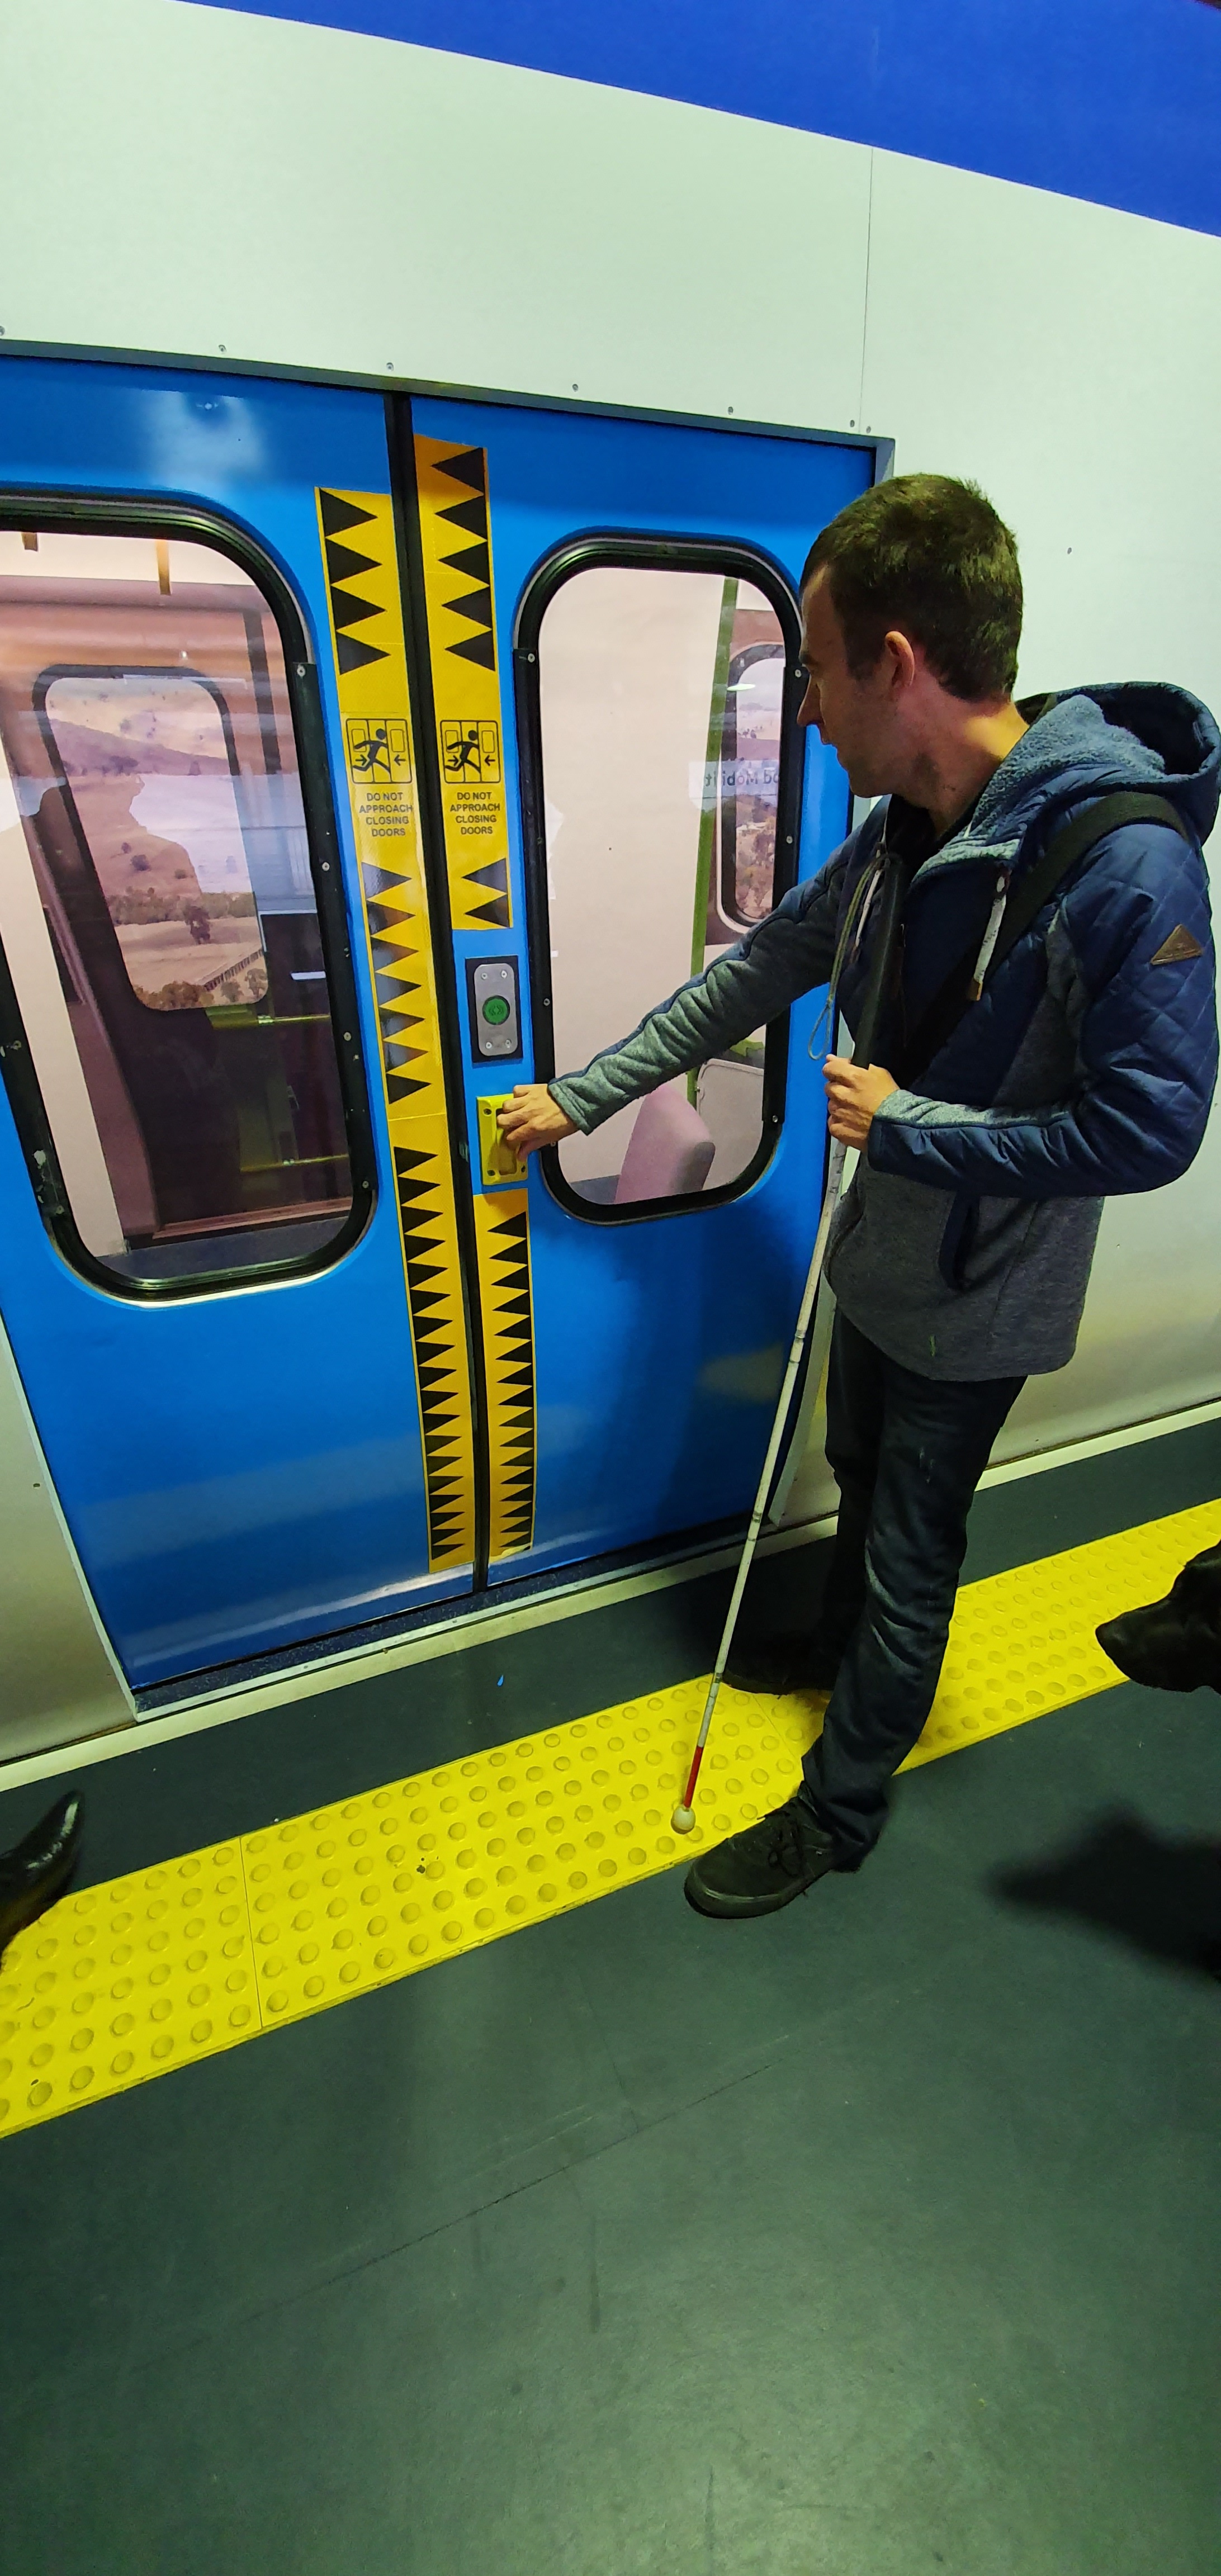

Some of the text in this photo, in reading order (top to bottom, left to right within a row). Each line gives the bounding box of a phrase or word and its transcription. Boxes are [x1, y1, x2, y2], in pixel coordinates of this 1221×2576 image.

[366, 792, 403, 801] DO NOT
[457, 792, 492, 801] DO NOT
[359, 804, 413, 813] APPROACH
[449, 803, 500, 812] APPROACH
[366, 816, 409, 825] CLOSING
[455, 815, 497, 823] CLOSING
[371, 828, 406, 837] DOORS
[460, 826, 493, 835] DOORS
